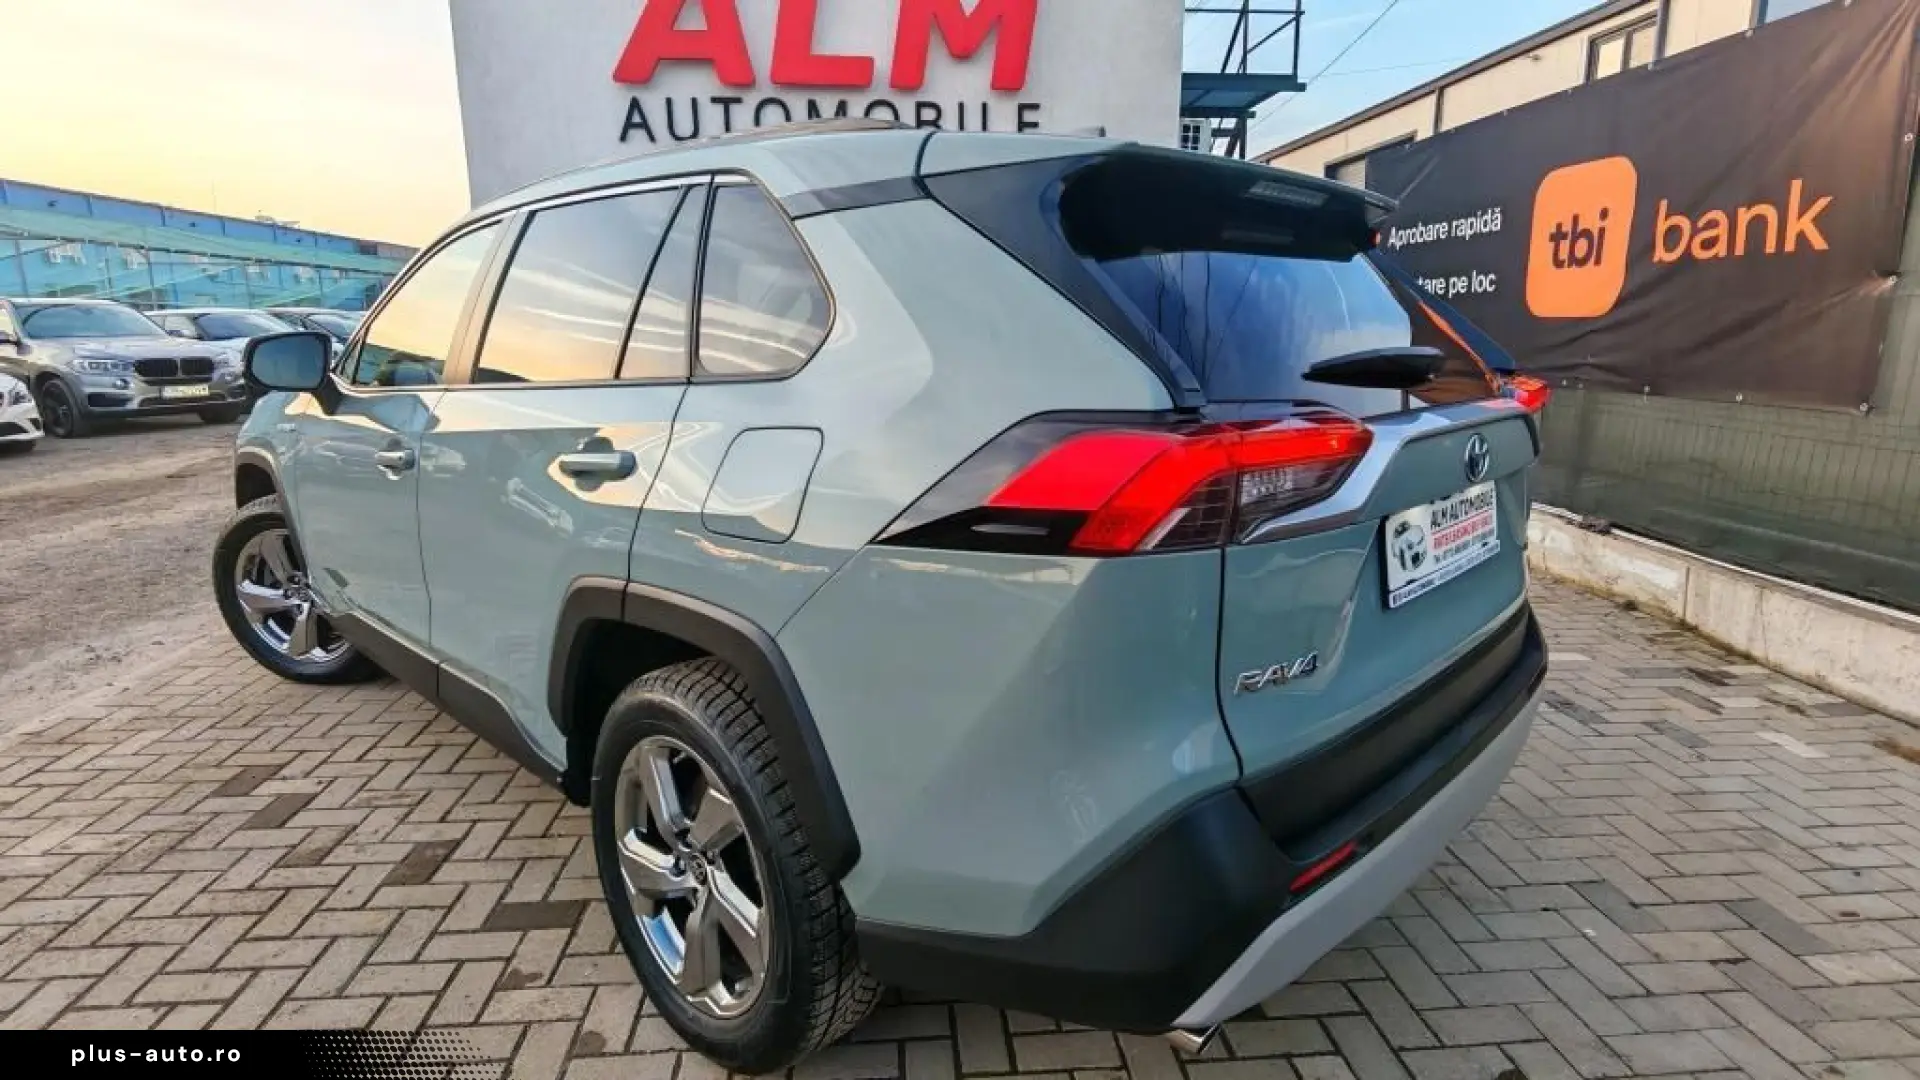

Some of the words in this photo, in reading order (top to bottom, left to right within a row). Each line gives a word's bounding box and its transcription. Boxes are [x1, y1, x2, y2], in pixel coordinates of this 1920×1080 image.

[613, 0, 1037, 91] ALM
[1387, 220, 1449, 251] Aprobare
[1451, 207, 1501, 240] rapidă
[1549, 207, 1609, 269] tbi
[1653, 178, 1833, 262] bank
[1448, 275, 1469, 299] pe
[1471, 269, 1497, 294] loc
[1233, 651, 1318, 696] RAV4
